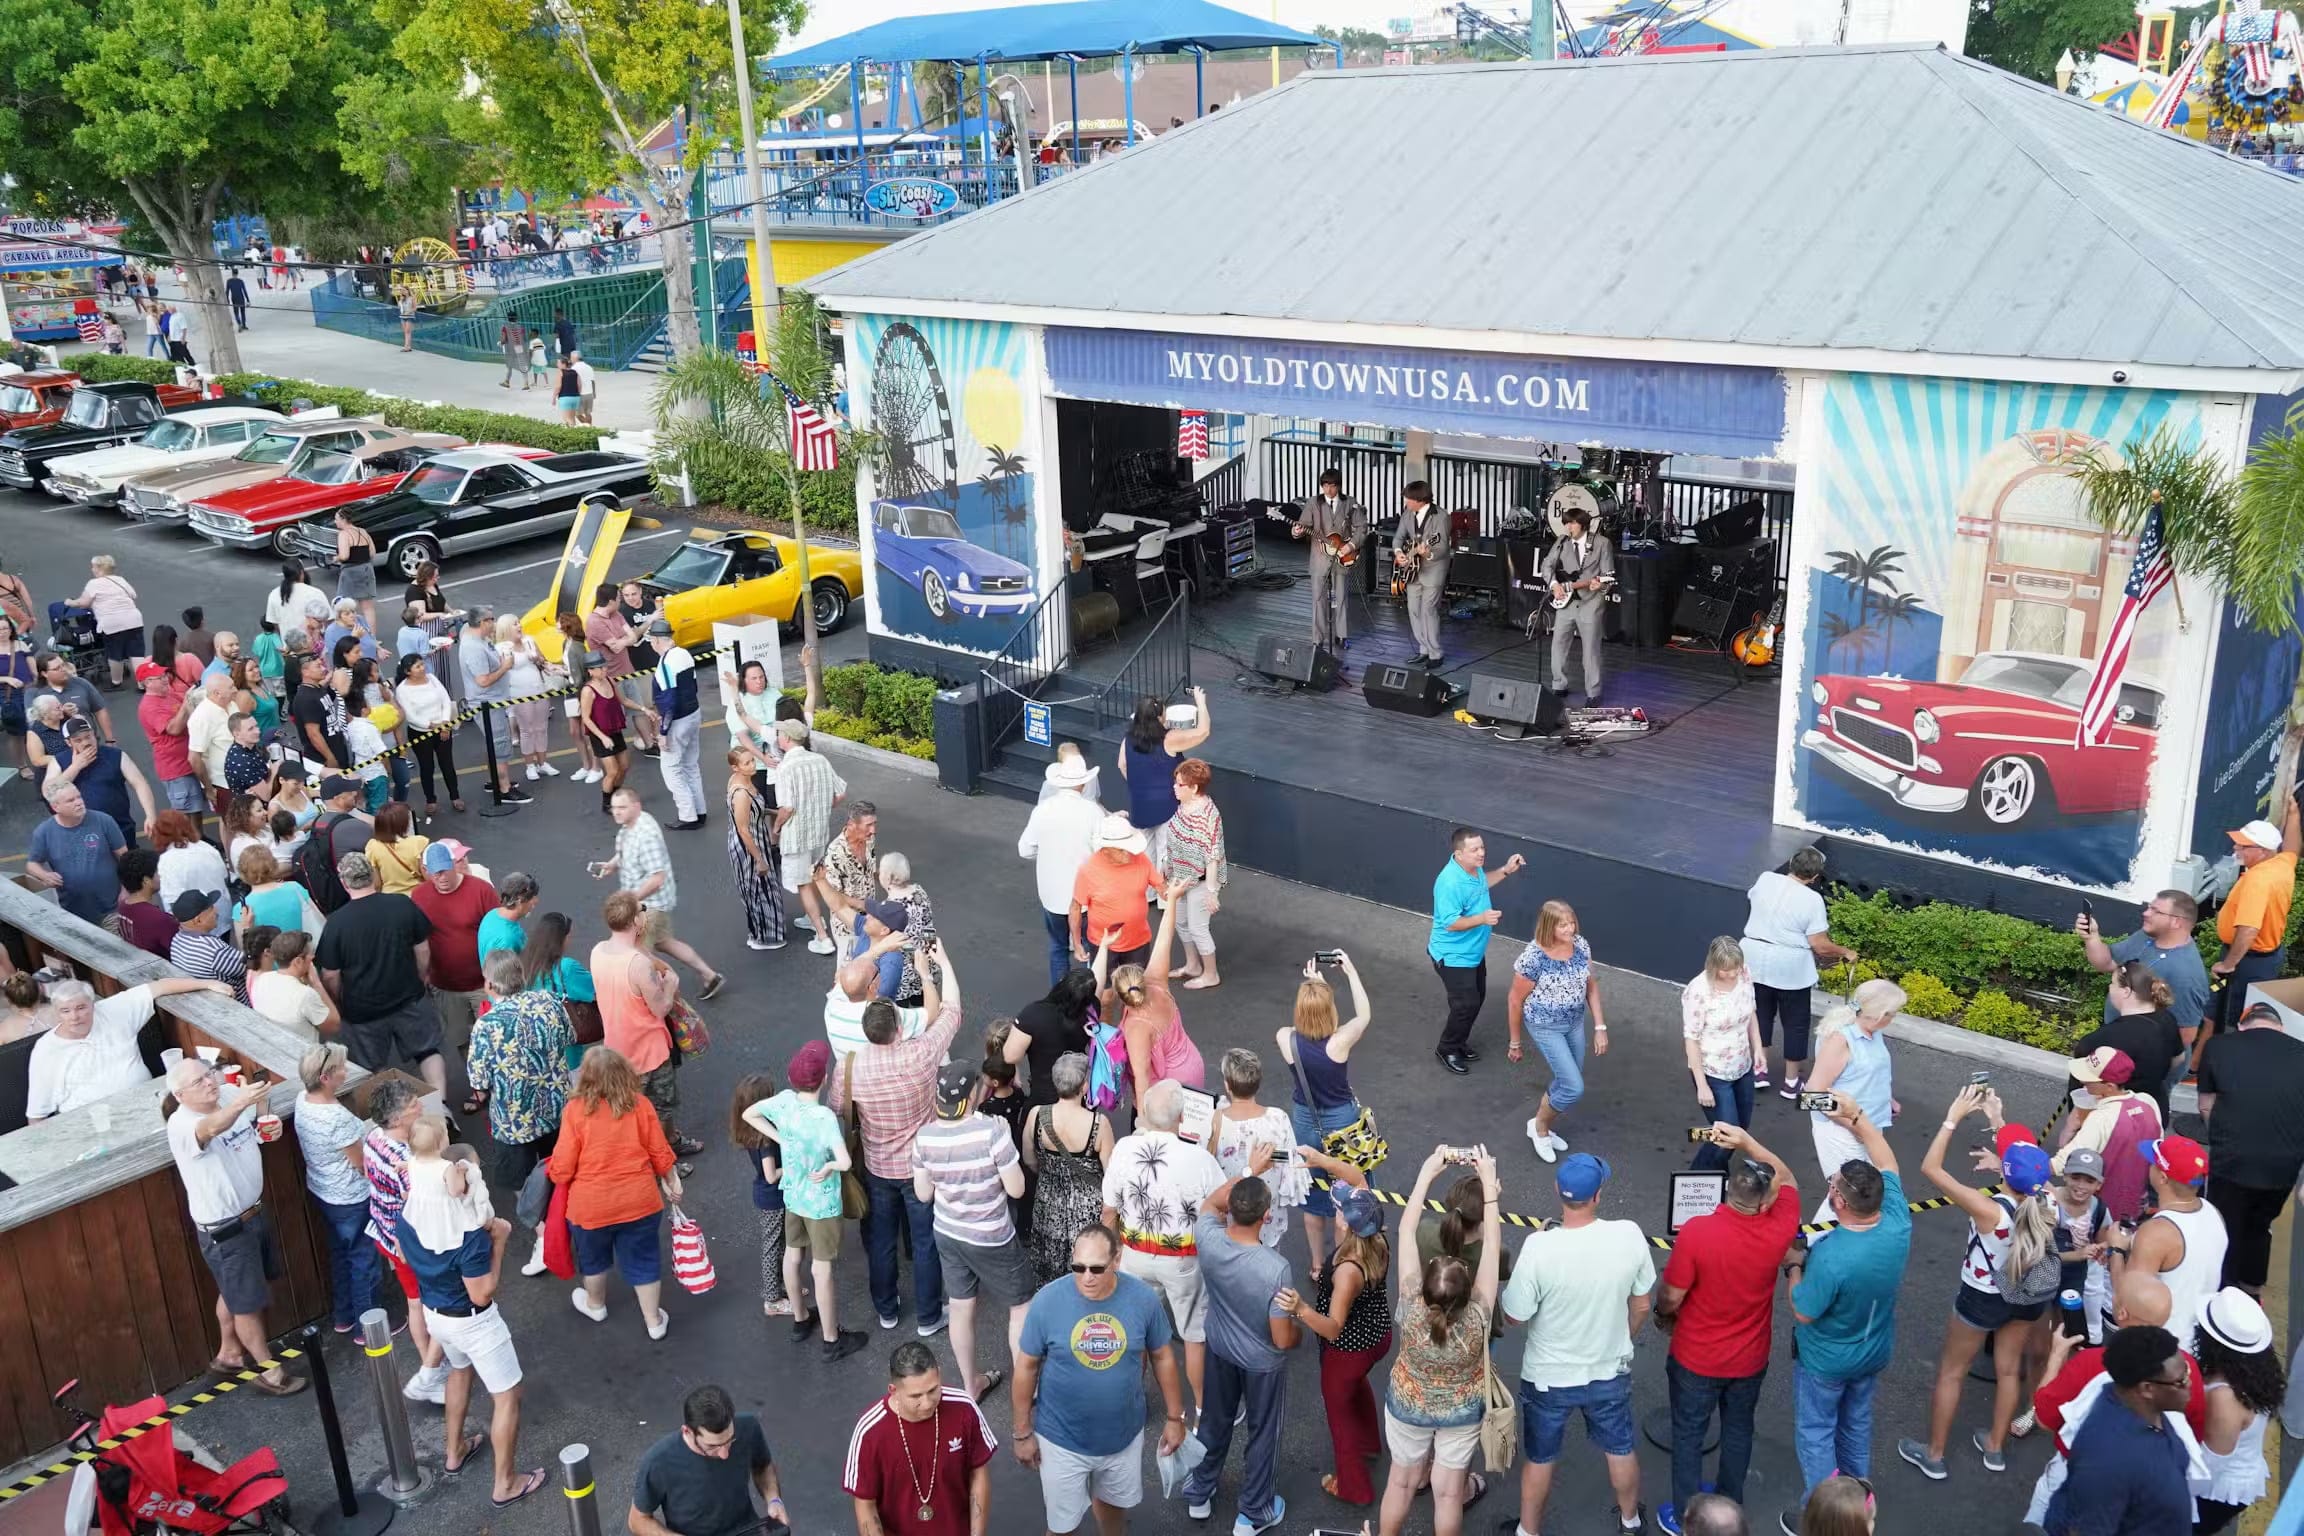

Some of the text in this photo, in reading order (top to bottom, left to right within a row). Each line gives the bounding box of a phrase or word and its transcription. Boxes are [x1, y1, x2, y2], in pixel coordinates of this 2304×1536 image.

[11, 221, 65, 234] POPCORN
[4, 248, 90, 263] CARAMEL APPLES
[1167, 350, 1590, 411] MYOLDTOWNUSA.COM
[752, 642, 769, 651] TRASH
[754, 652, 768, 660] ONLY
[1078, 1341, 1121, 1349] CHEVROLET
[1088, 1359, 1112, 1368] PARTS
